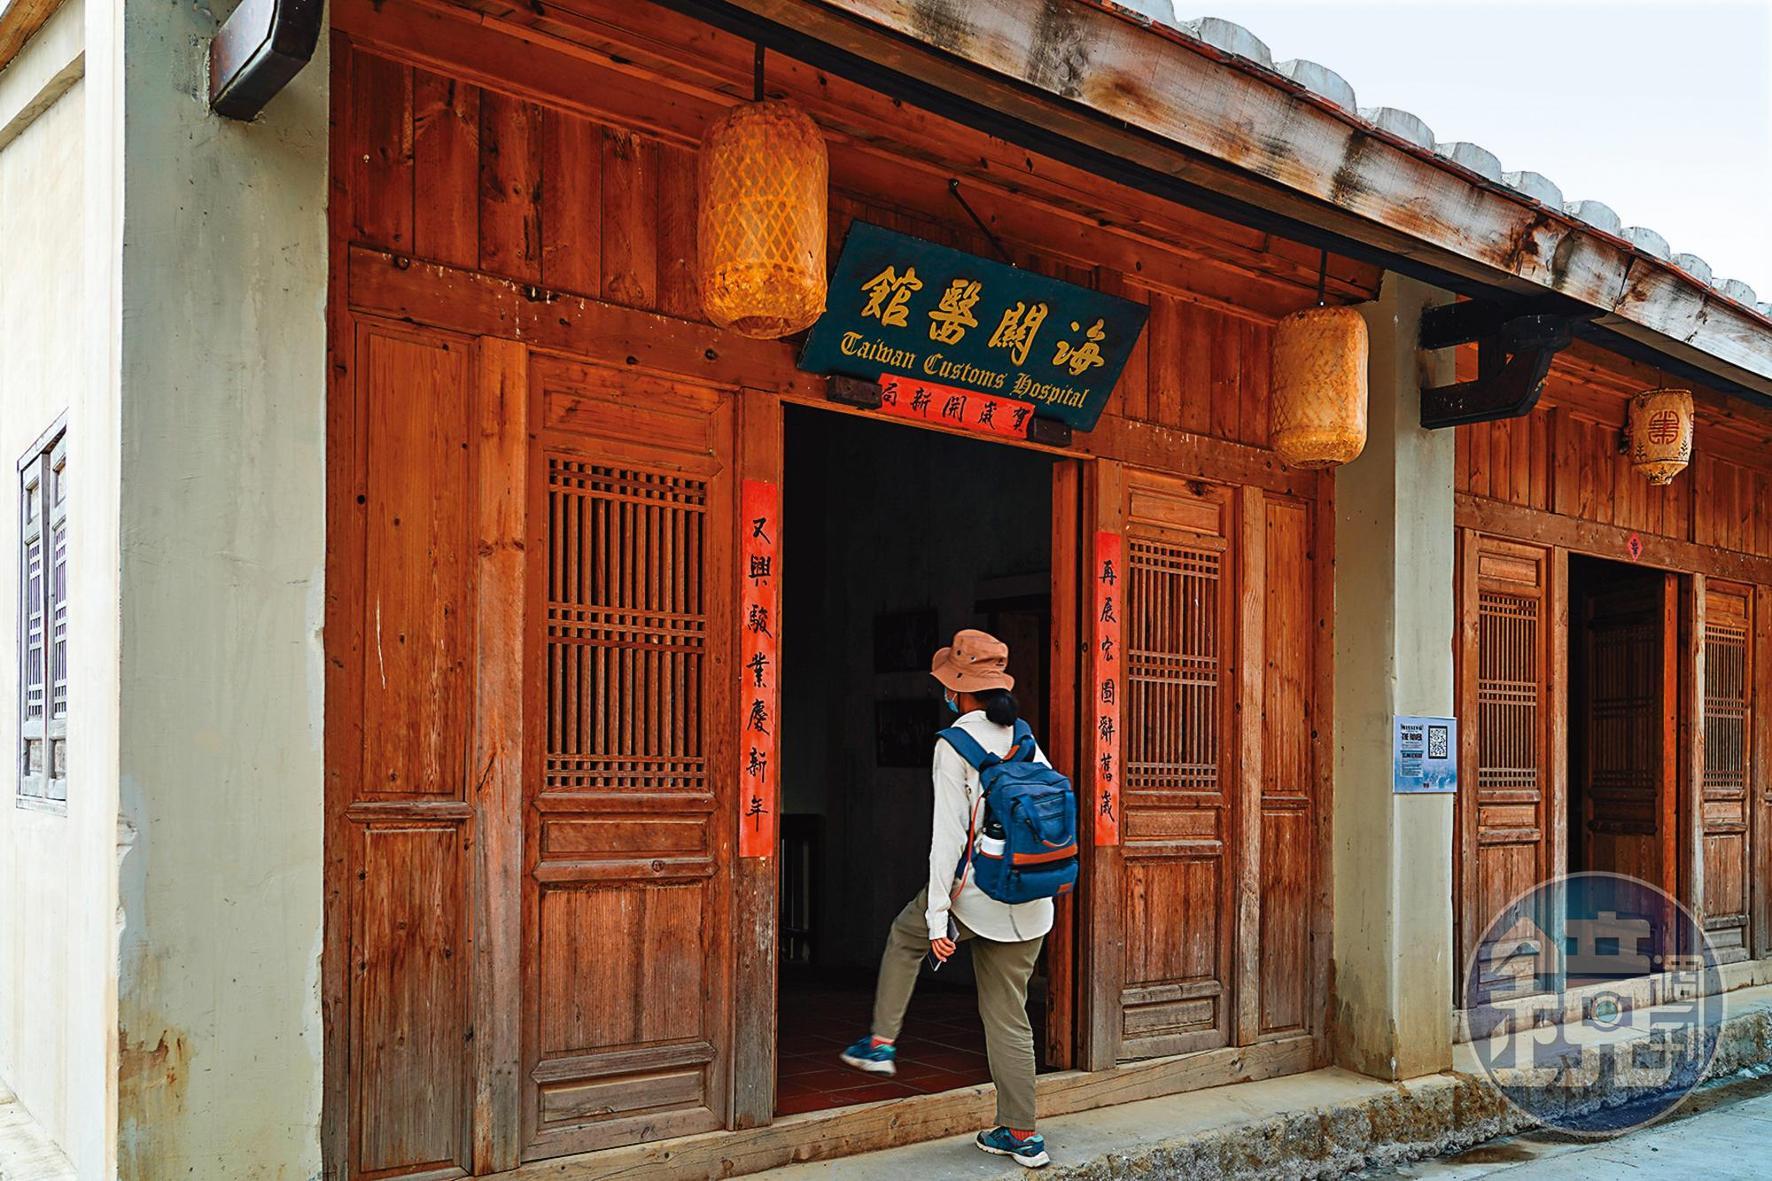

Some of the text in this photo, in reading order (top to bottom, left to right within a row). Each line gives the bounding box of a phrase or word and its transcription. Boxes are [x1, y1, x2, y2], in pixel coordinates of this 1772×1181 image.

[840, 330, 1091, 410] Taiwan Customs Hospital
[745, 517, 772, 832] 又興駿業慶新年
